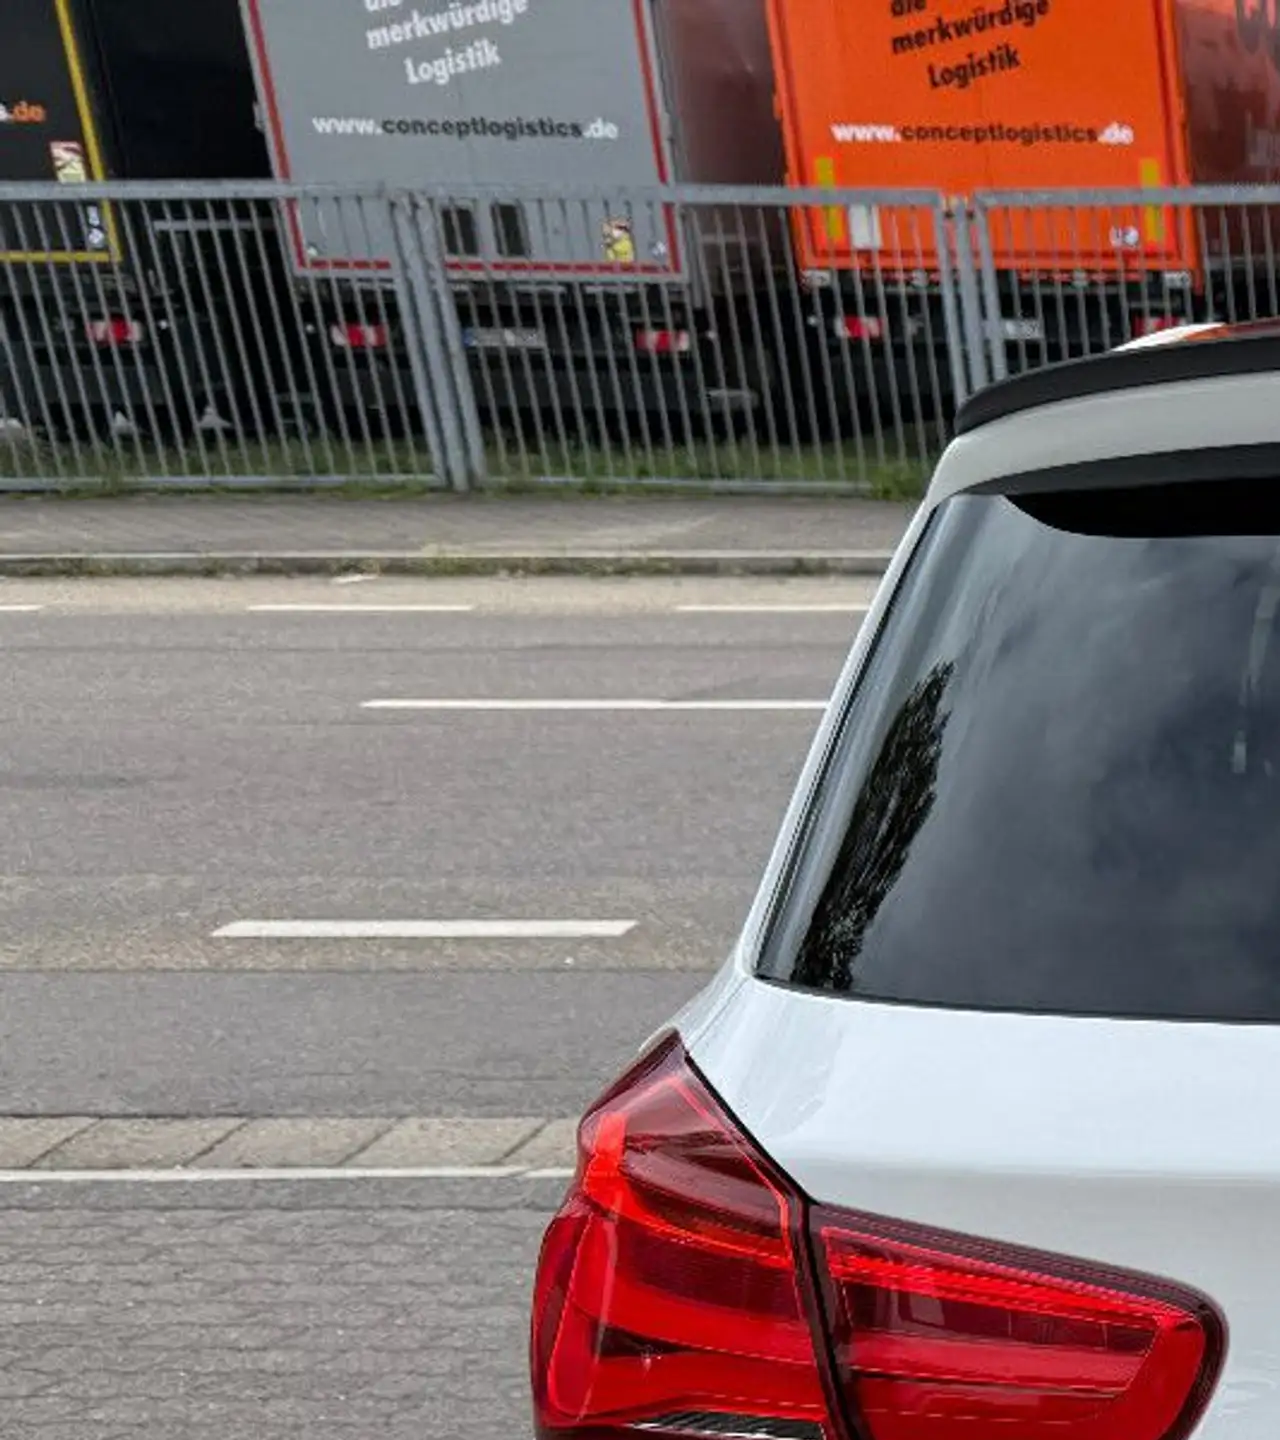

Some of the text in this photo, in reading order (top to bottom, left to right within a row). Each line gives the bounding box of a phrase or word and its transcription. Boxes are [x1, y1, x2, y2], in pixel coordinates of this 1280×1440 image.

[891, 0, 1049, 54] merkwürdige
[403, 37, 501, 85] Logistik
[927, 43, 1021, 89] Logistik
[311, 105, 619, 141] www.conceptlogistics.de
[830, 120, 1134, 147] www.conceptlogistics.de
